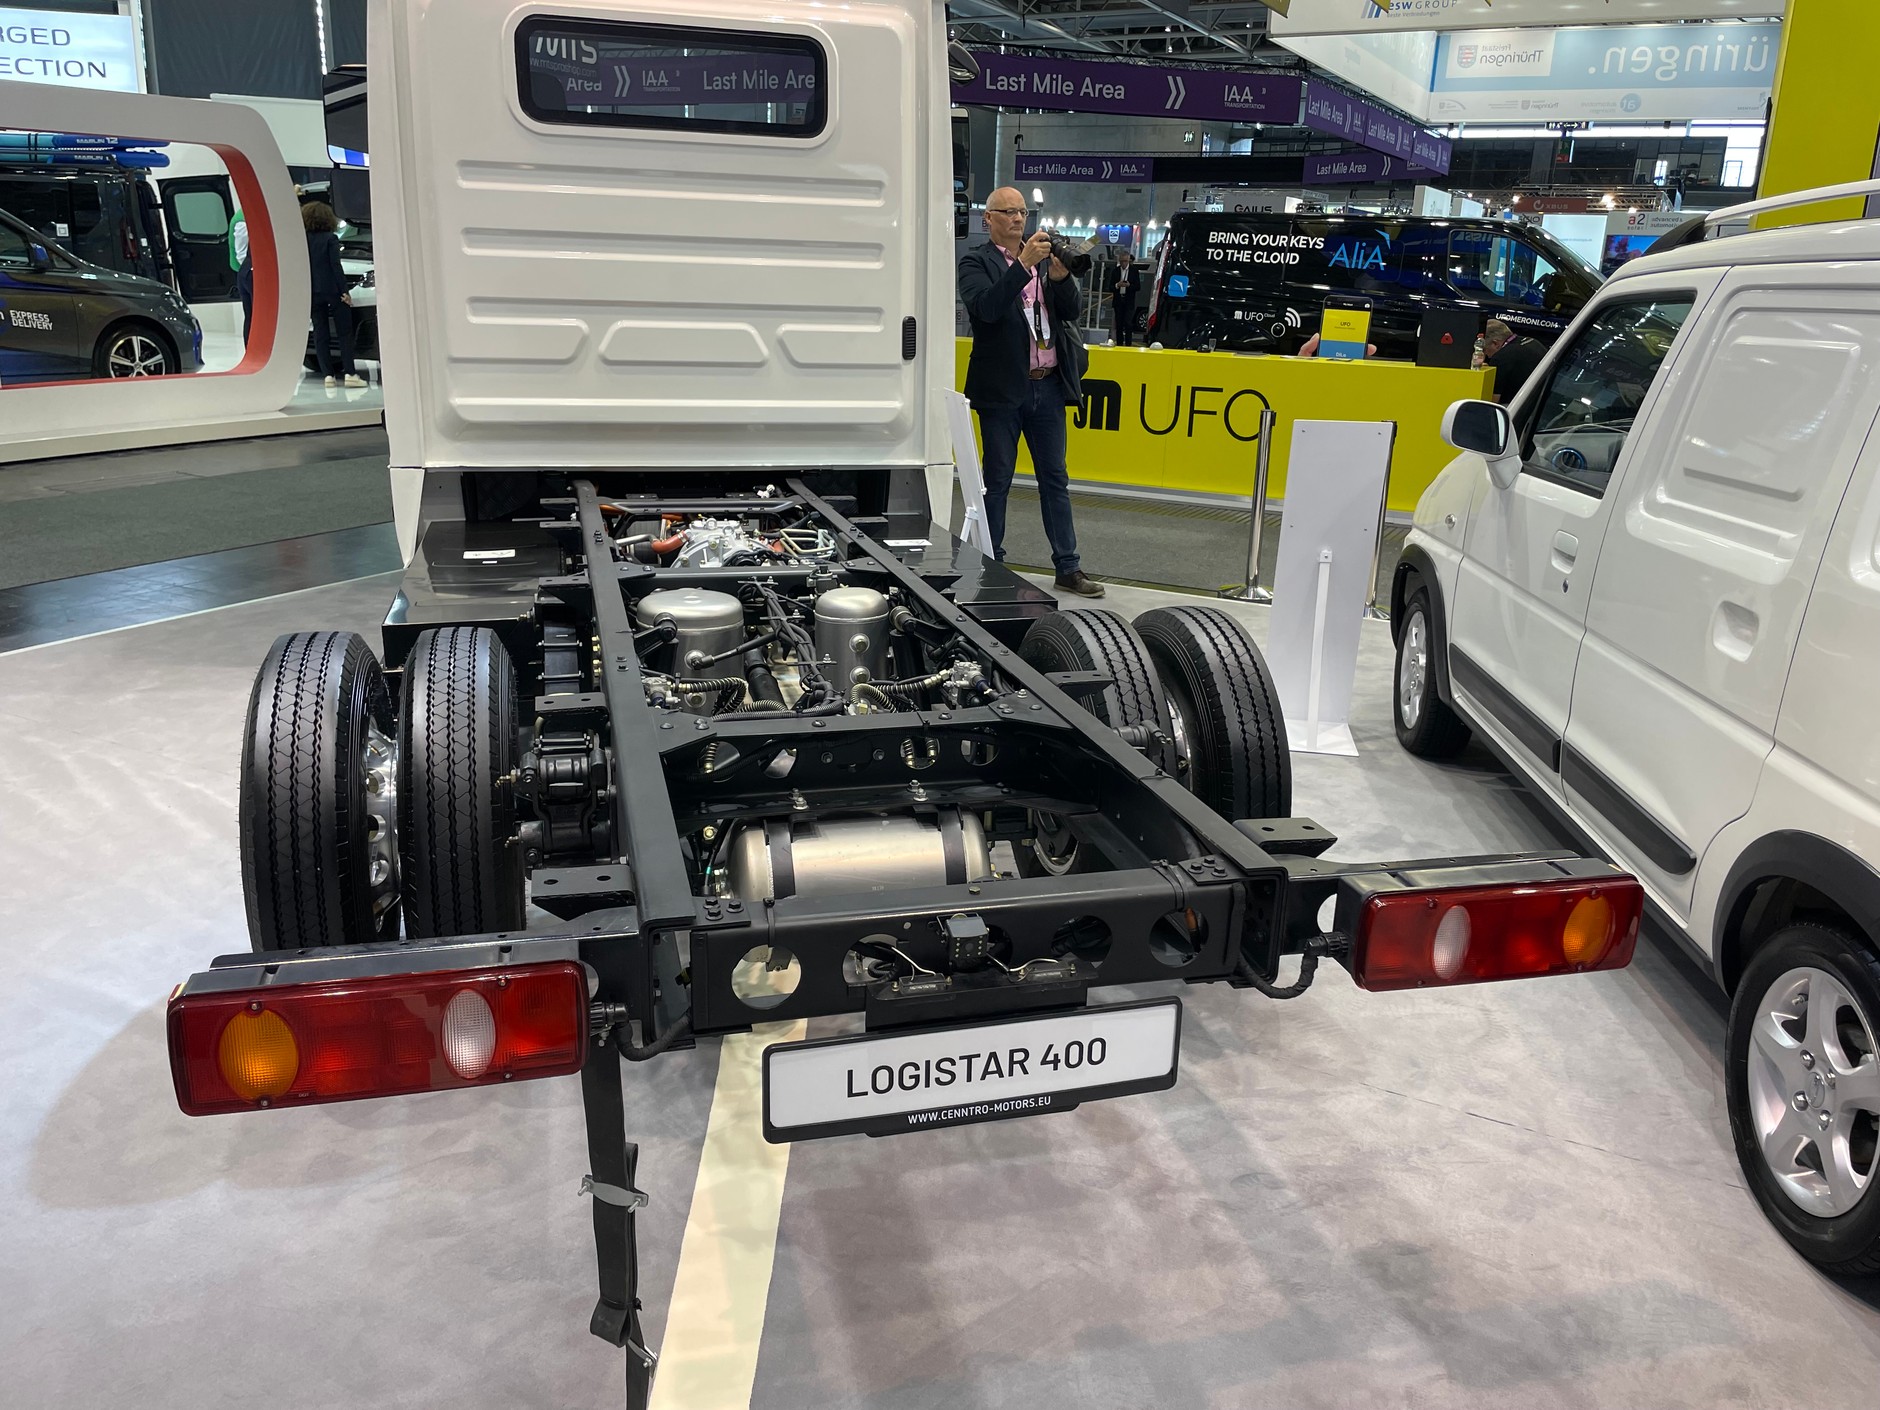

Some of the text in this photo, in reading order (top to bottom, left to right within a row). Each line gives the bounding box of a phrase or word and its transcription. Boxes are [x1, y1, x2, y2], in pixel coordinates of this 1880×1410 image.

[1415, 0, 1457, 10] GROUP
[0, 26, 71, 46] GED
[642, 70, 669, 87] IAA
[703, 70, 738, 90] Last
[742, 69, 779, 90] Mile
[985, 68, 1125, 99] Last Mile Area
[1224, 84, 1254, 103] IAA
[1223, 101, 1266, 110] TRANSPORTATION
[1308, 95, 1344, 126] Last Mile Area
[105, 136, 119, 145] 12
[1368, 119, 1378, 138] Last
[1376, 123, 1387, 142] Mile
[1386, 126, 1396, 146] Area
[1022, 163, 1094, 175] Last Mile Area
[1120, 164, 1138, 174] IAA
[1316, 160, 1367, 175] Last Mile Area
[1208, 231, 1325, 249] BRING YOUR KEYS
[1206, 248, 1300, 265] TO THE CLOUD
[1328, 241, 1386, 271] AliA
[9, 309, 50, 323] EXPRESS
[12, 318, 53, 331] DELIVERY
[1244, 311, 1264, 321] UFO
[1139, 382, 1271, 442] UFO
[845, 1036, 1108, 1099] LOGISTAR 400
[907, 1095, 1052, 1125] WWW.CENNTRO-MOTORS.EU
